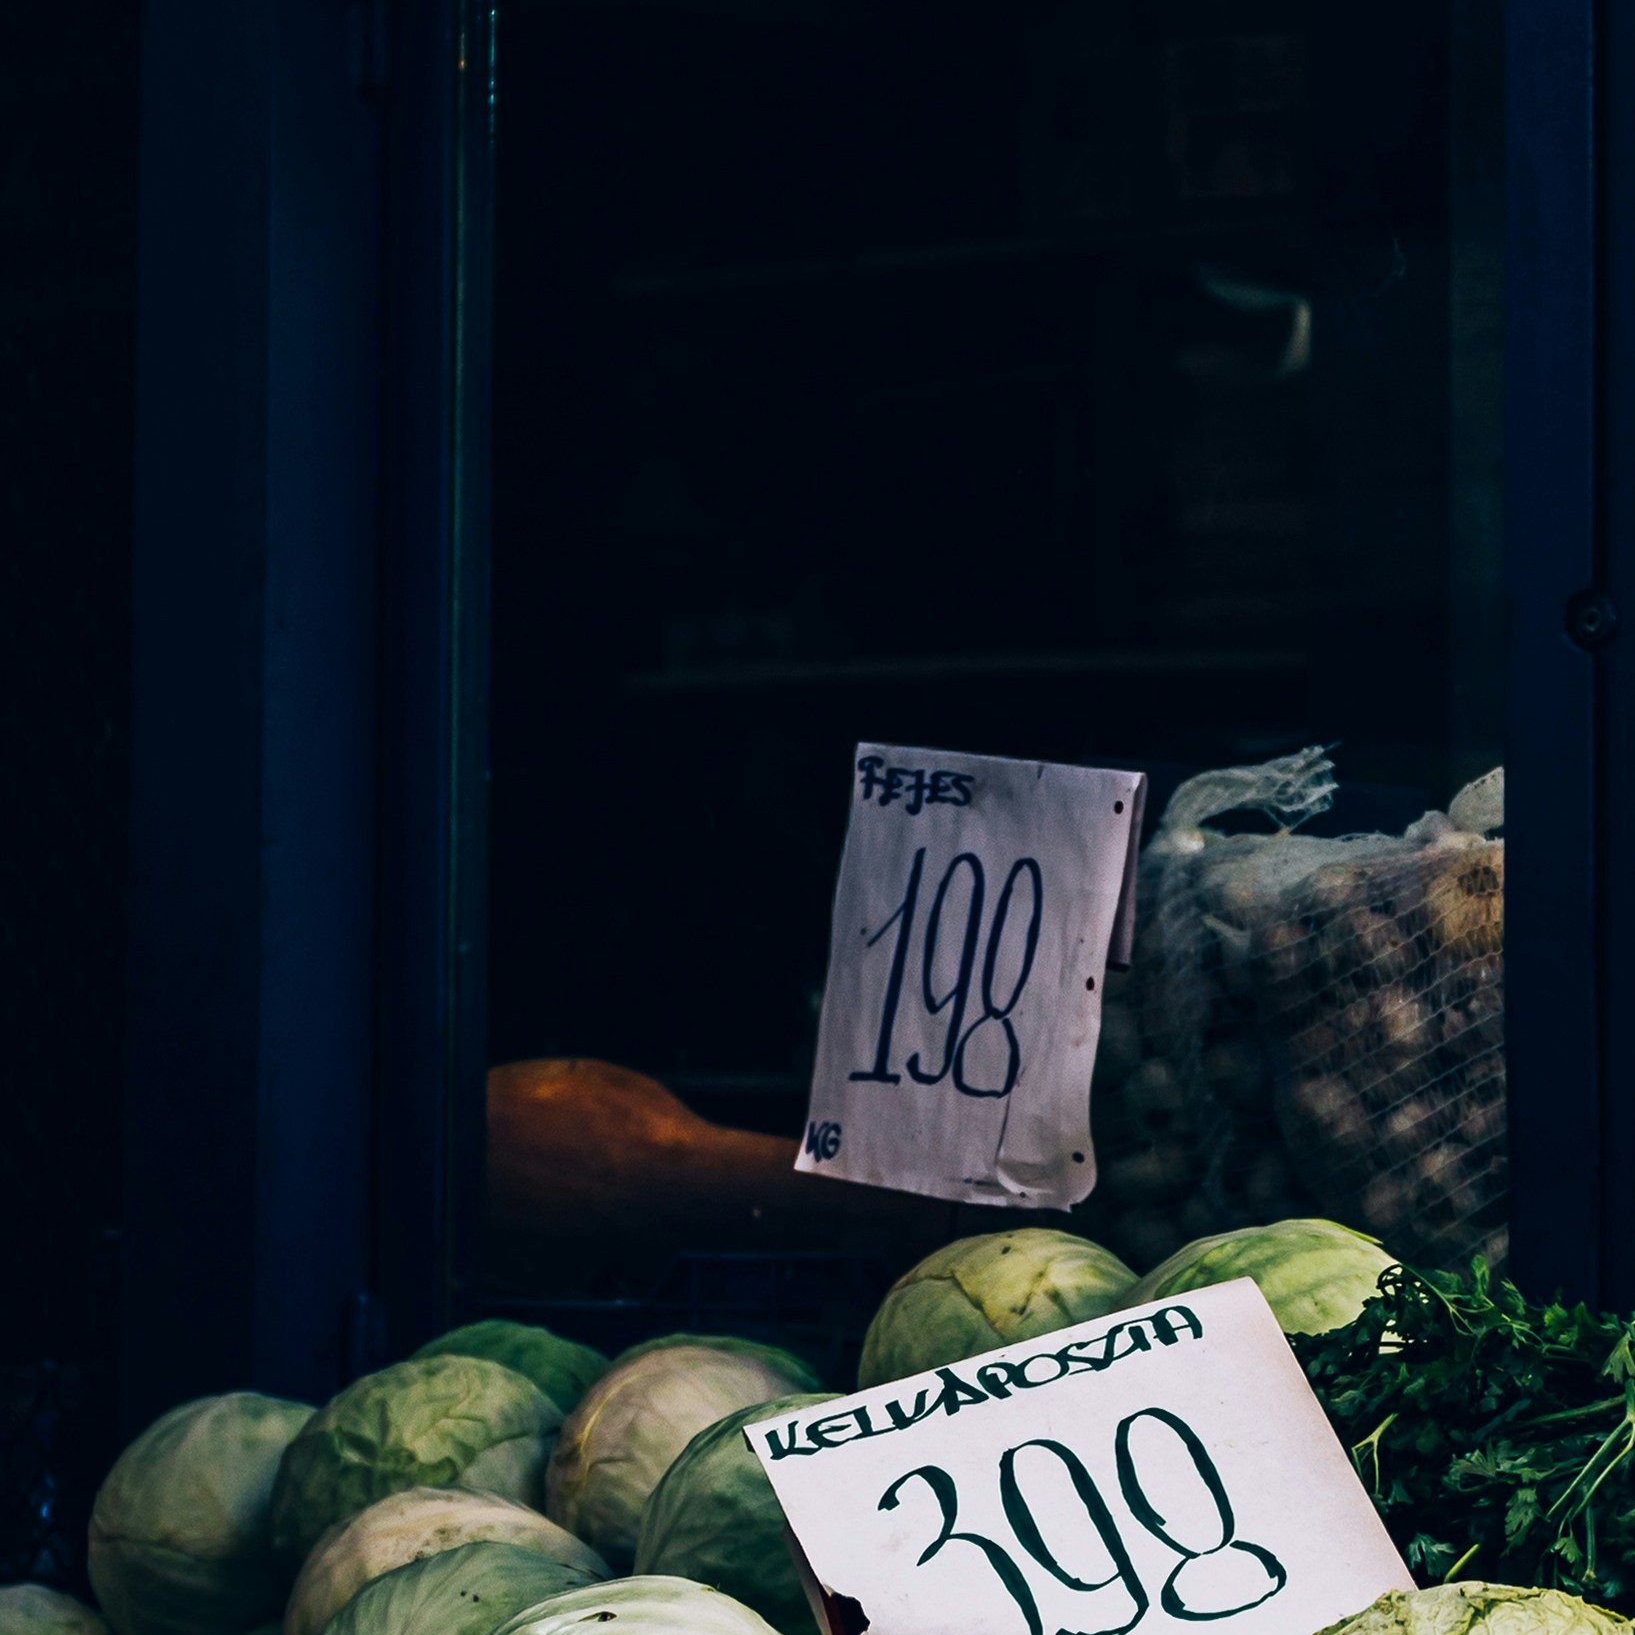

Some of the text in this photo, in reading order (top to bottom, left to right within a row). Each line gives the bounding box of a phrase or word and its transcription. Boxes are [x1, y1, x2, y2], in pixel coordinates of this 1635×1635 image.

[857, 755, 975, 816] FEJES
[848, 847, 1043, 1099] 198
[806, 1121, 843, 1163] KG
